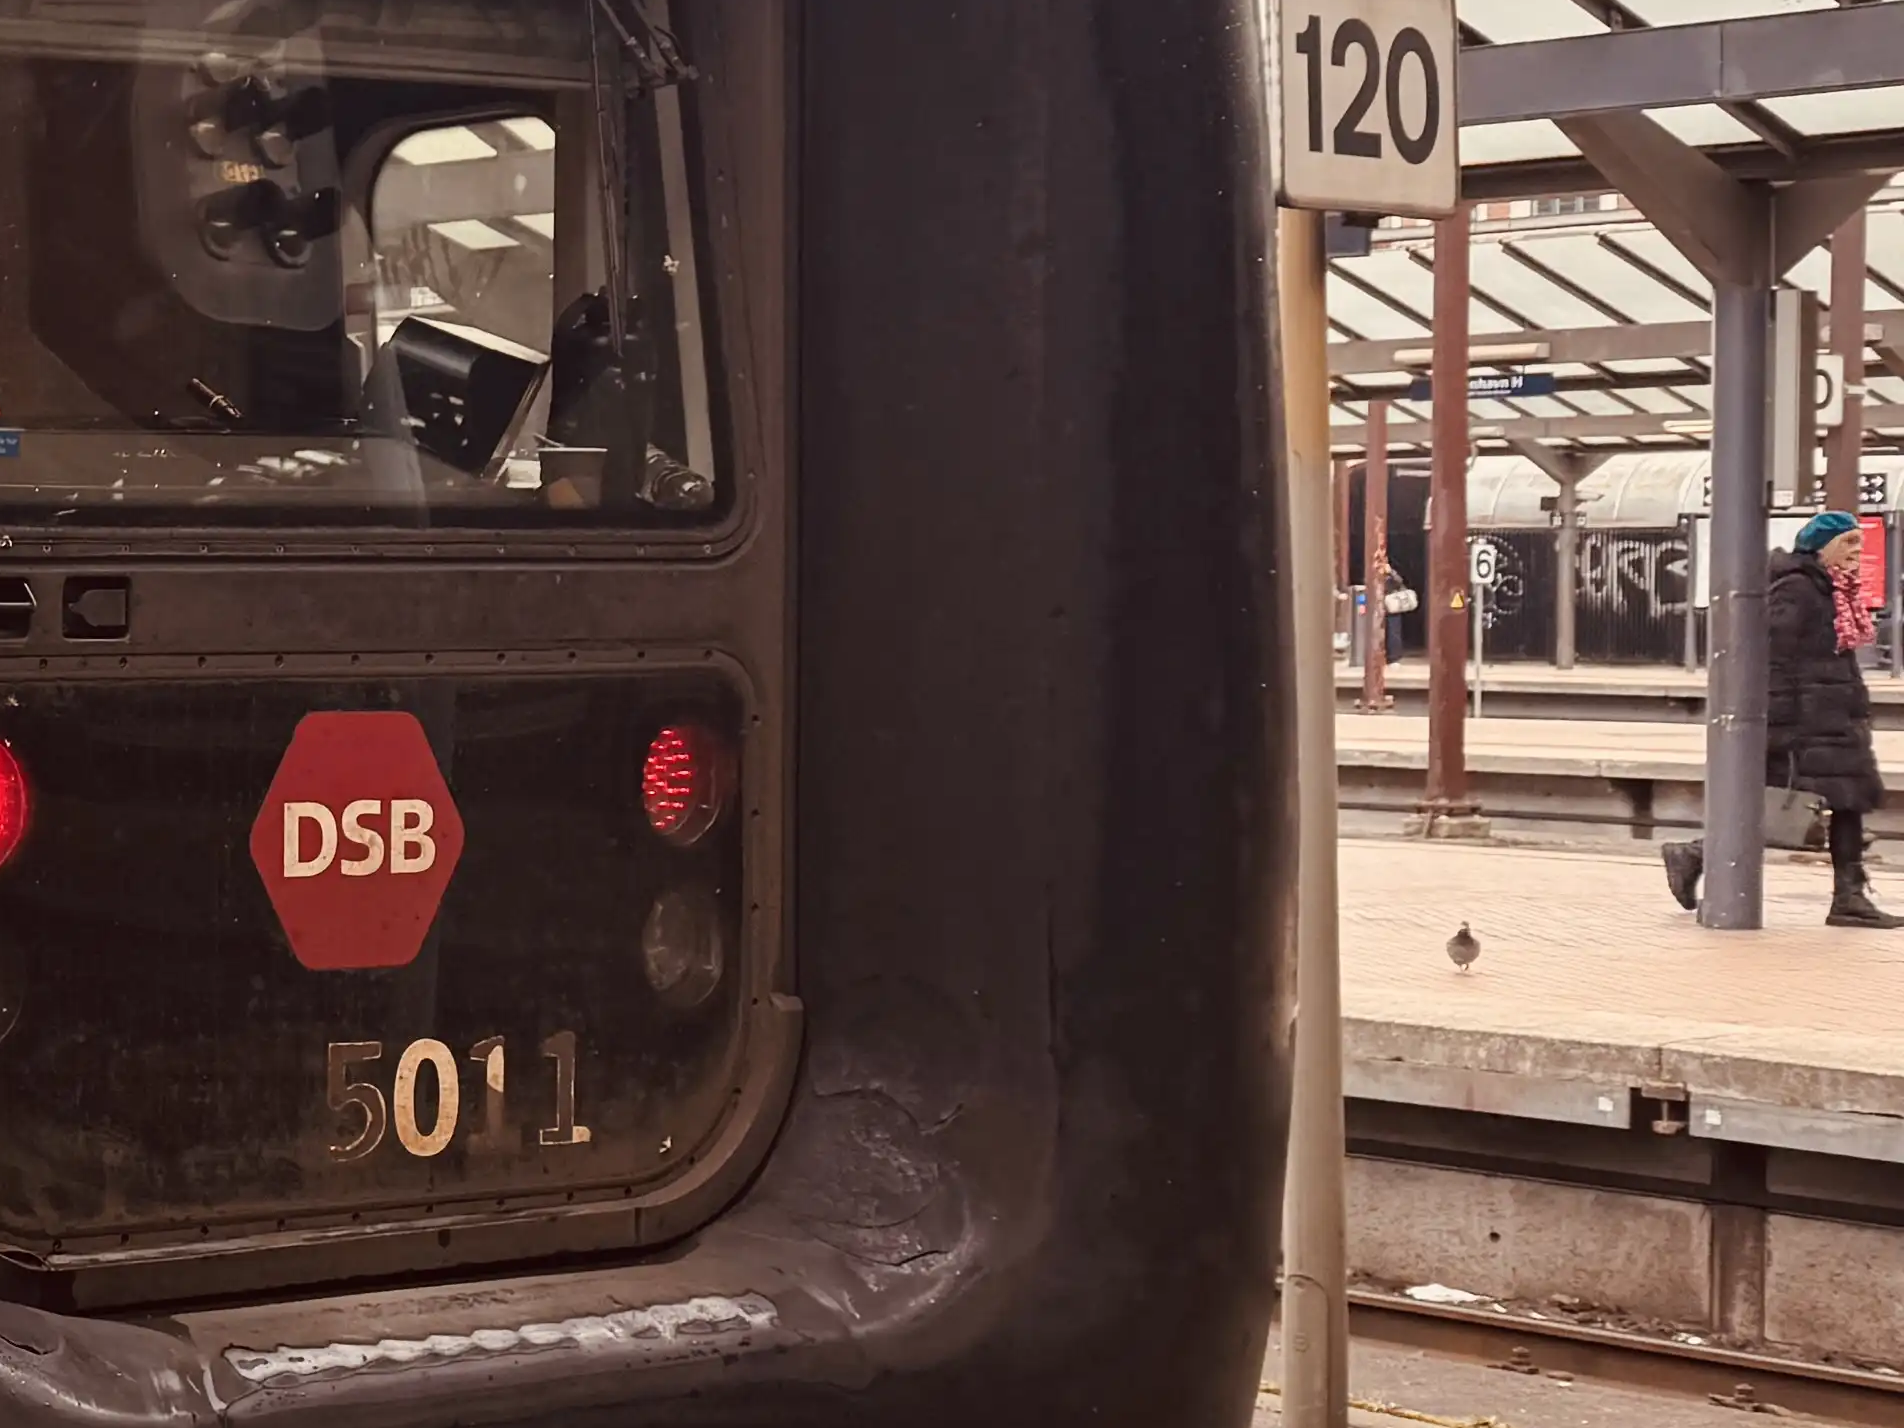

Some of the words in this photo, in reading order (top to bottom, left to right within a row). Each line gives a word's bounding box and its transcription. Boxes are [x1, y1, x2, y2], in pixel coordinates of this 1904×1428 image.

[1296, 14, 1440, 165] 120
[1476, 549, 1492, 579] 6
[283, 798, 437, 878] DSB
[326, 1030, 592, 1163] 5011
